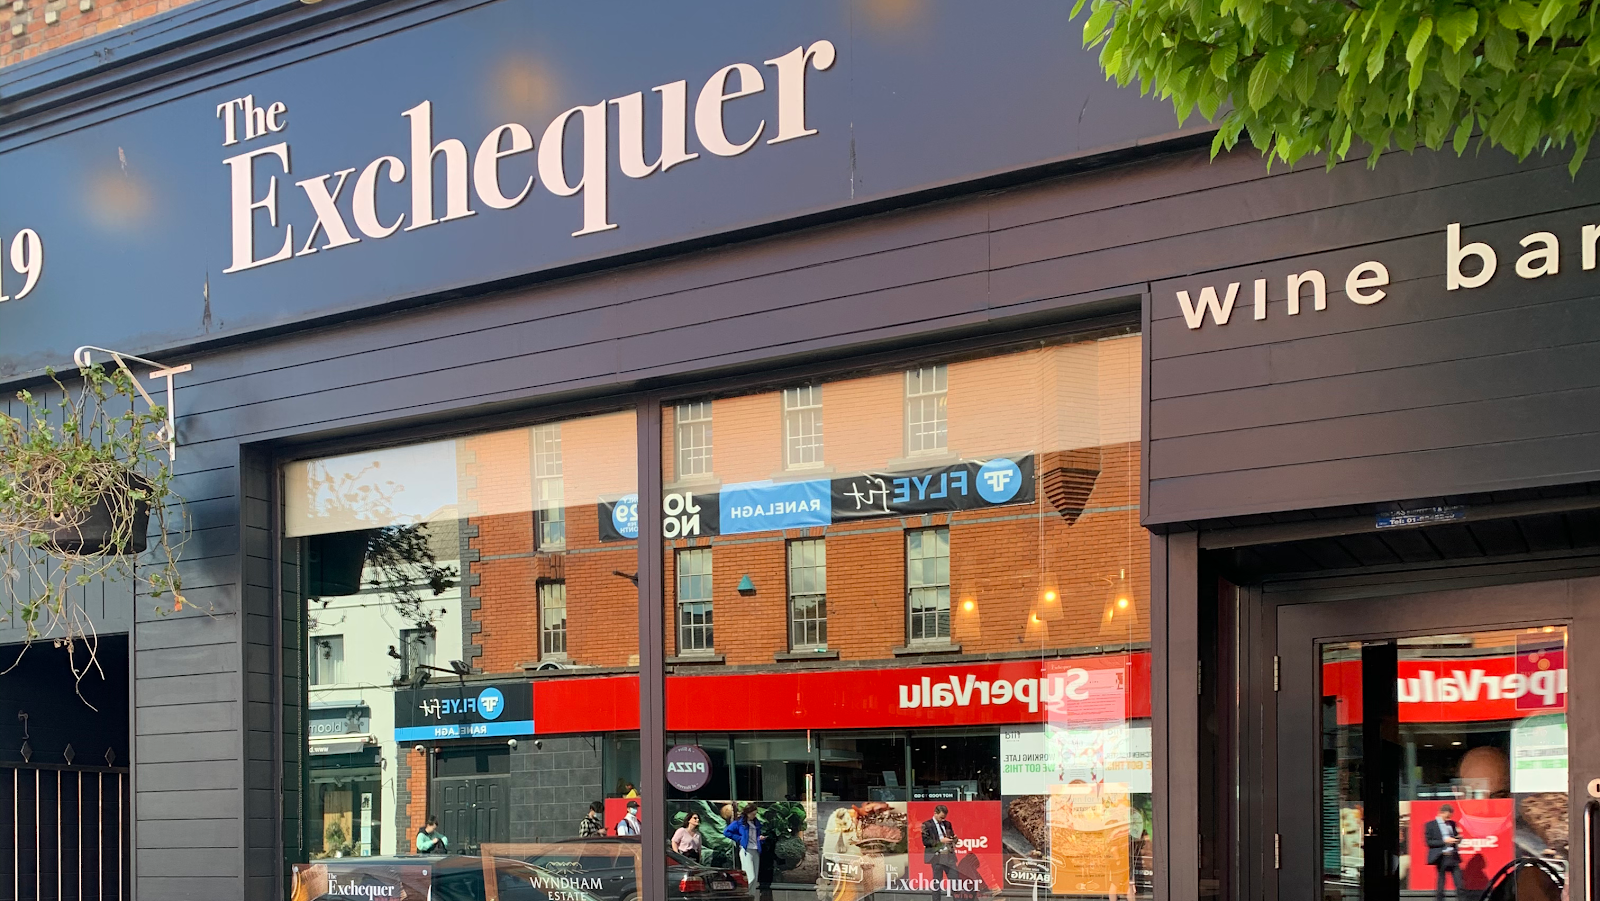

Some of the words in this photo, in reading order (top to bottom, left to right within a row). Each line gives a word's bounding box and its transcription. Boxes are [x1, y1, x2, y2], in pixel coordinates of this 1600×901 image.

[216, 93, 288, 148] The
[222, 39, 837, 275] Exchequer
[1176, 260, 1391, 330] wine
[1446, 222, 1600, 291] bar
[885, 864, 898, 872] The
[328, 880, 395, 901] Exchequer
[529, 876, 603, 890] WYNDHAM
[885, 872, 983, 898] Exchequer
[547, 891, 588, 901] ESTATE
